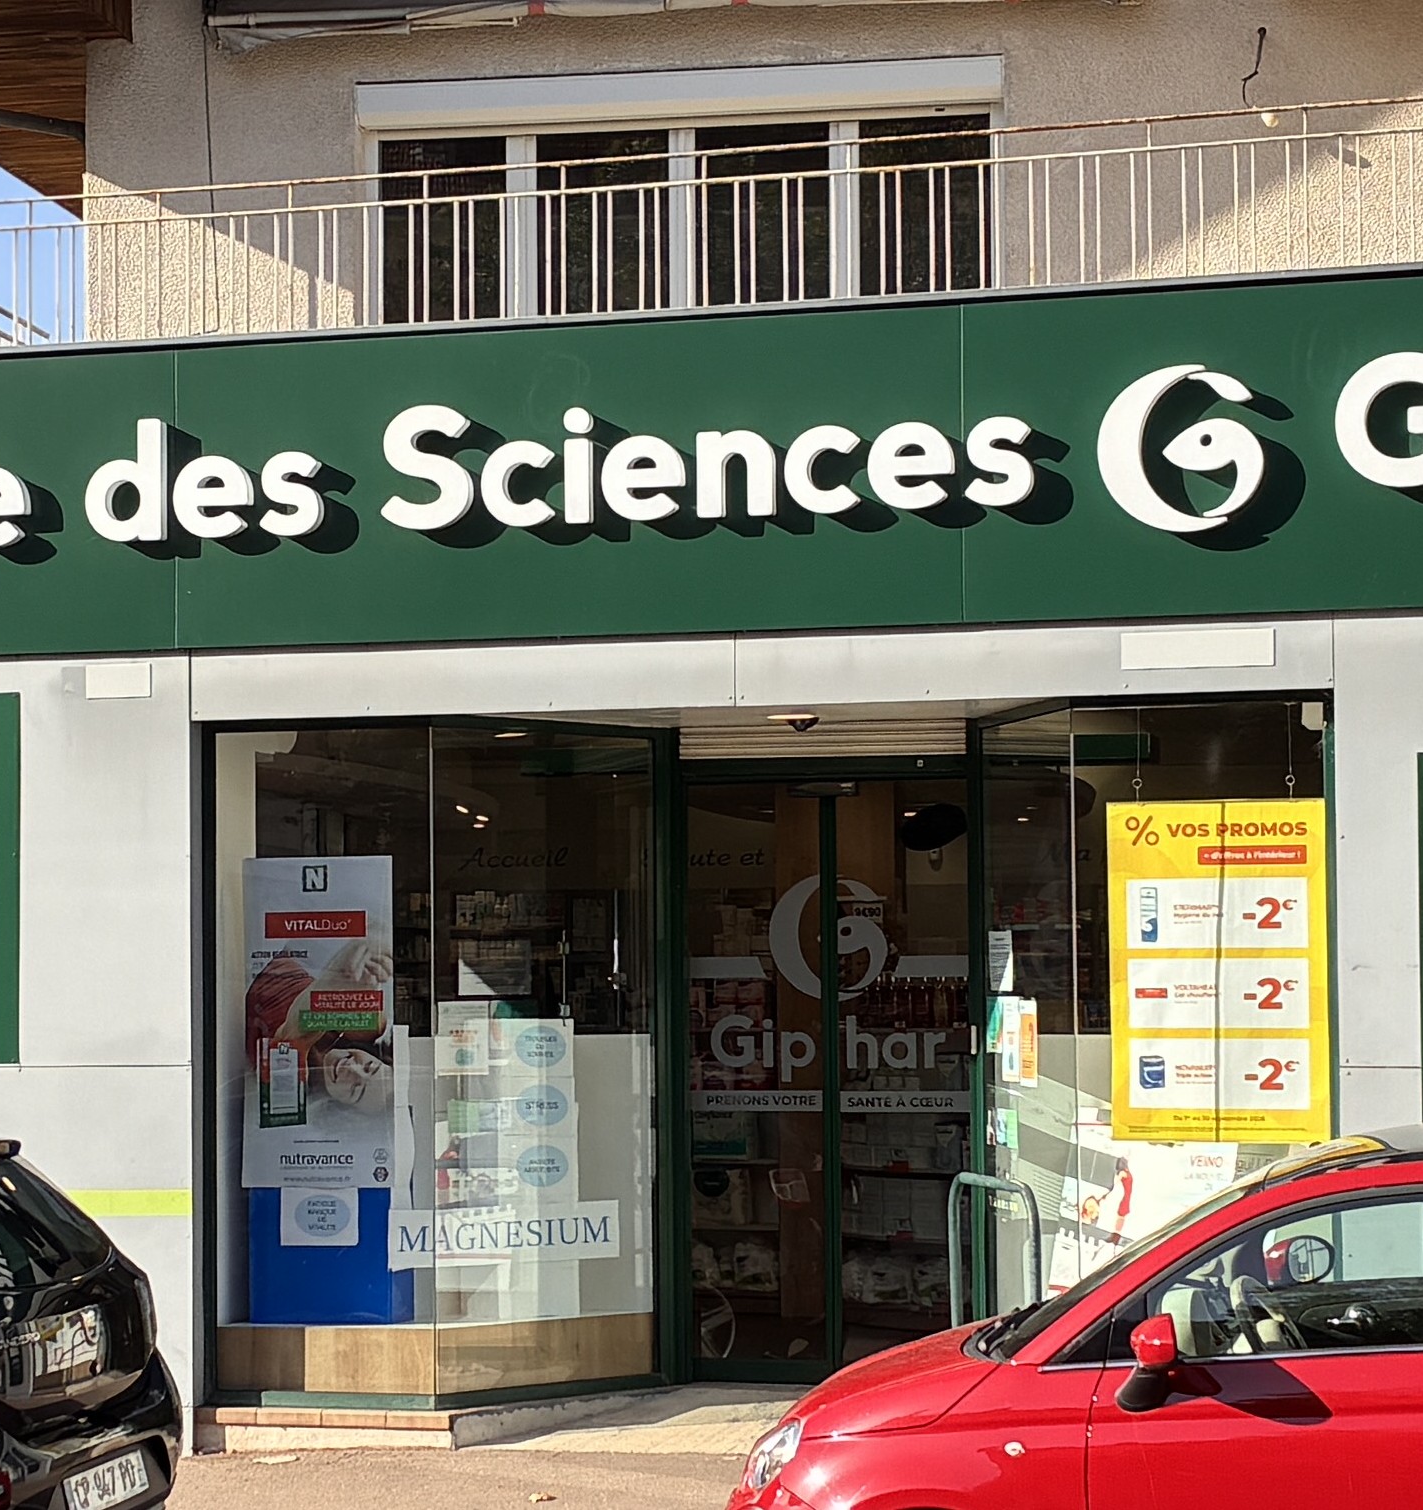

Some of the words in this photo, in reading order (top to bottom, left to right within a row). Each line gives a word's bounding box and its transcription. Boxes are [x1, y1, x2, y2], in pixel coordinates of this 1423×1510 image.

[84, 417, 325, 542] des
[380, 403, 1035, 534] Sciences
[1167, 823, 1210, 837] VOS
[1216, 822, 1308, 837] PROMOS
[458, 847, 569, 871] Accueil
[706, 1094, 770, 1107] PRENONS
[770, 1095, 817, 1107] VOTRE
[279, 1153, 355, 1166] nutravance
[397, 1215, 611, 1253] MAGNESIUM
